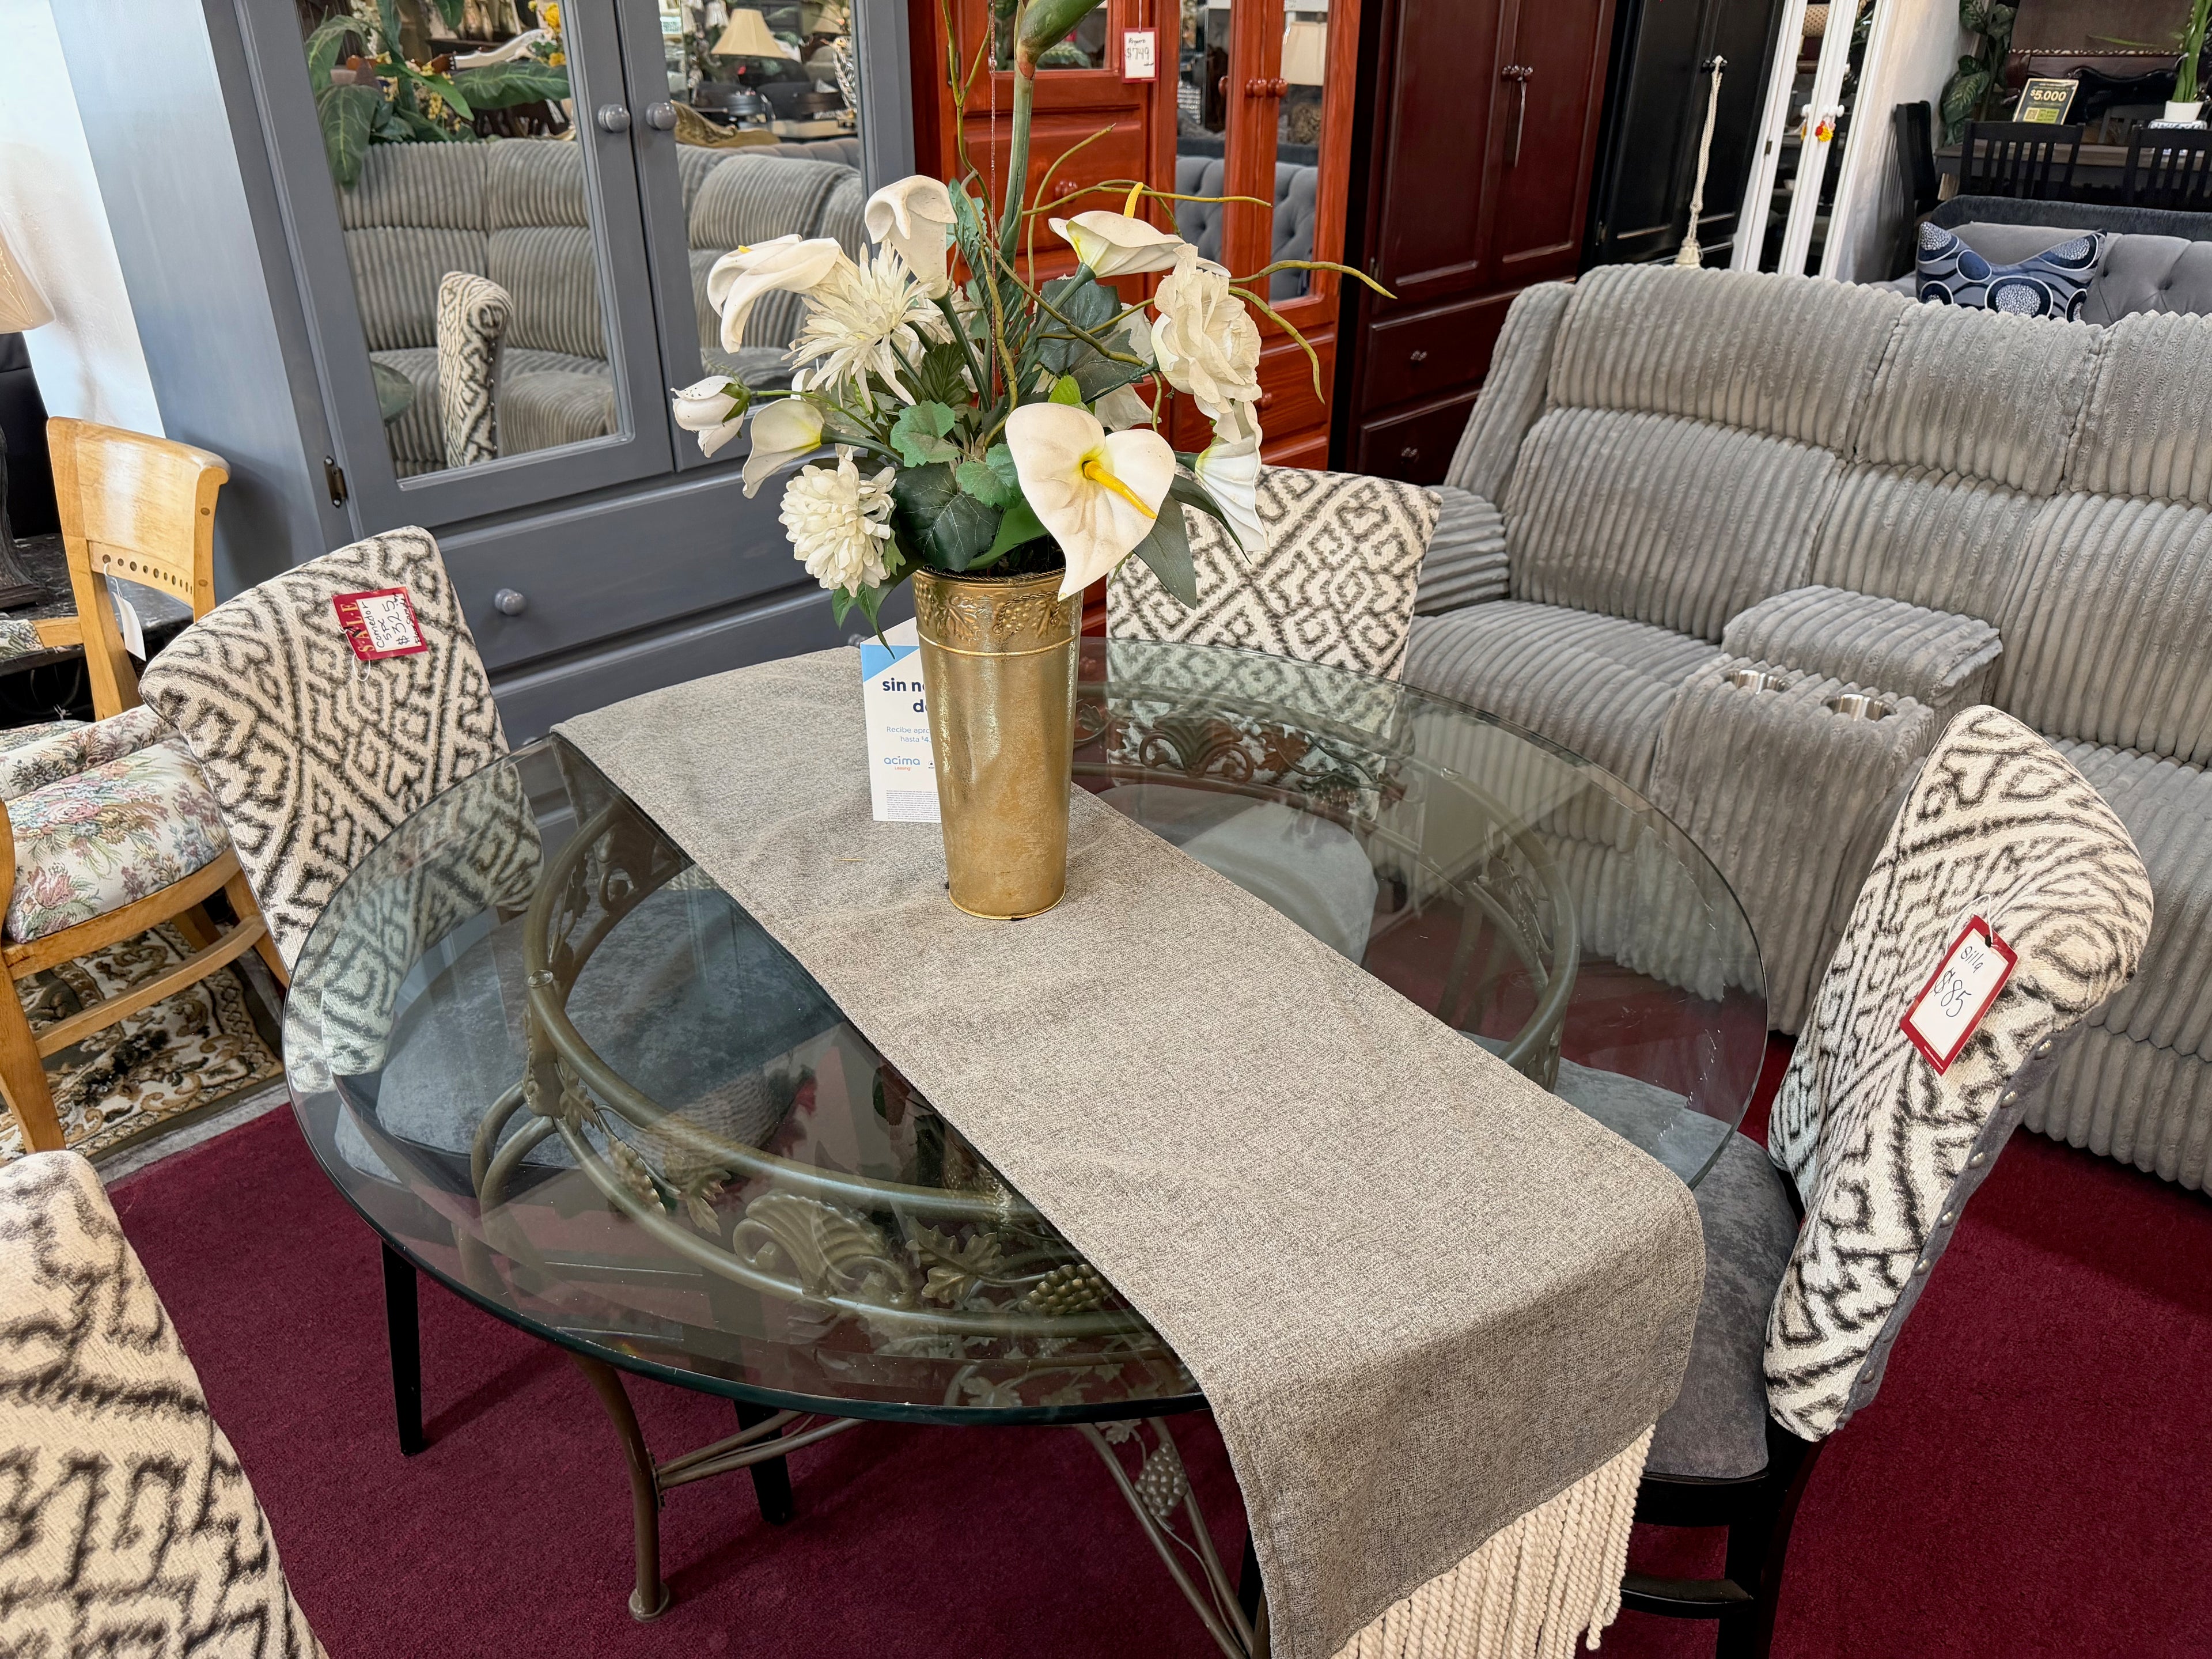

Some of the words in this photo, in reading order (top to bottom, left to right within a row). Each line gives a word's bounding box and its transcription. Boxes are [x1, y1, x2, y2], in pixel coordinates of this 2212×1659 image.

[362, 601, 385, 648] Comedor
[882, 677, 907, 691] sin
[884, 756, 921, 766] acima
[1960, 945, 1984, 974] Silla
[1930, 967, 1972, 1018] $85
